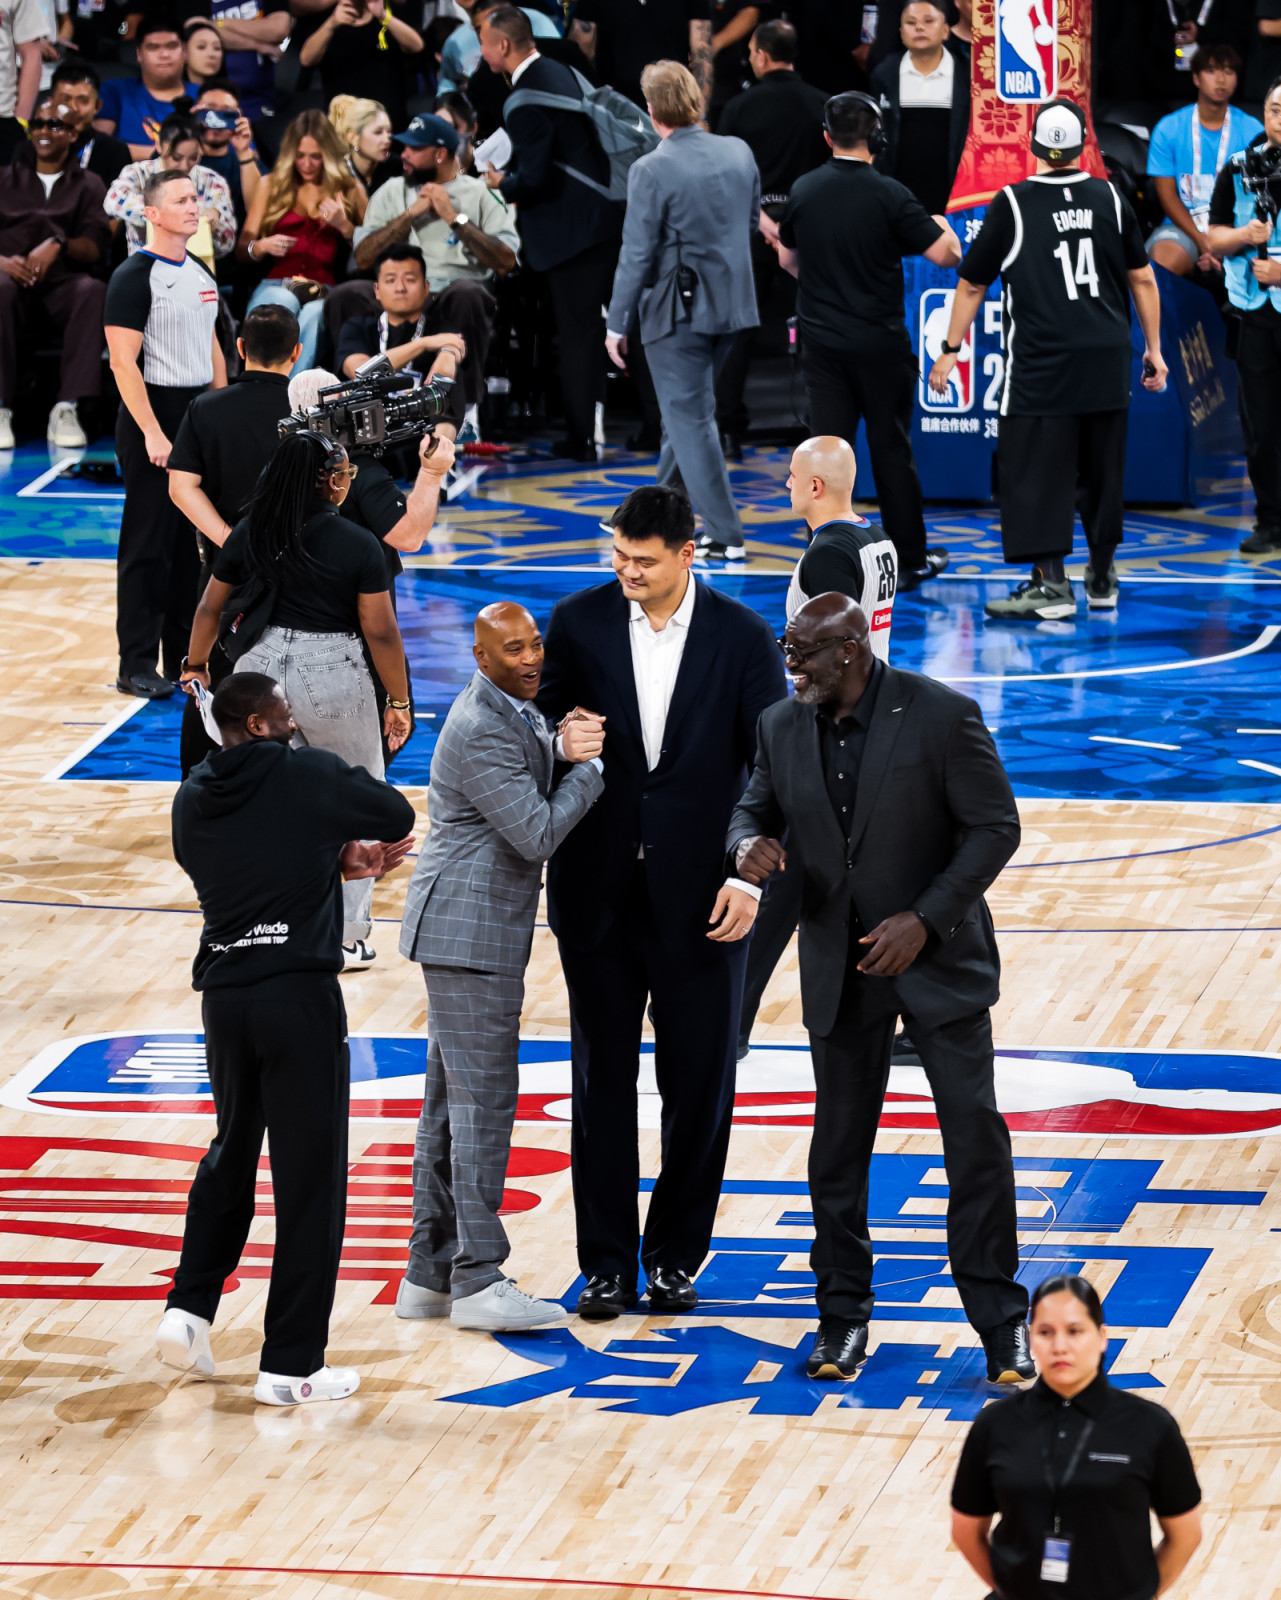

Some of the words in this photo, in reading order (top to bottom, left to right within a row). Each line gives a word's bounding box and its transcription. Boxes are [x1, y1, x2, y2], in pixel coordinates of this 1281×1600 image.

[1005, 71, 1035, 94] NBA
[1053, 237, 1100, 301] 14
[875, 551, 895, 602] 28
[253, 921, 289, 936] Wade
